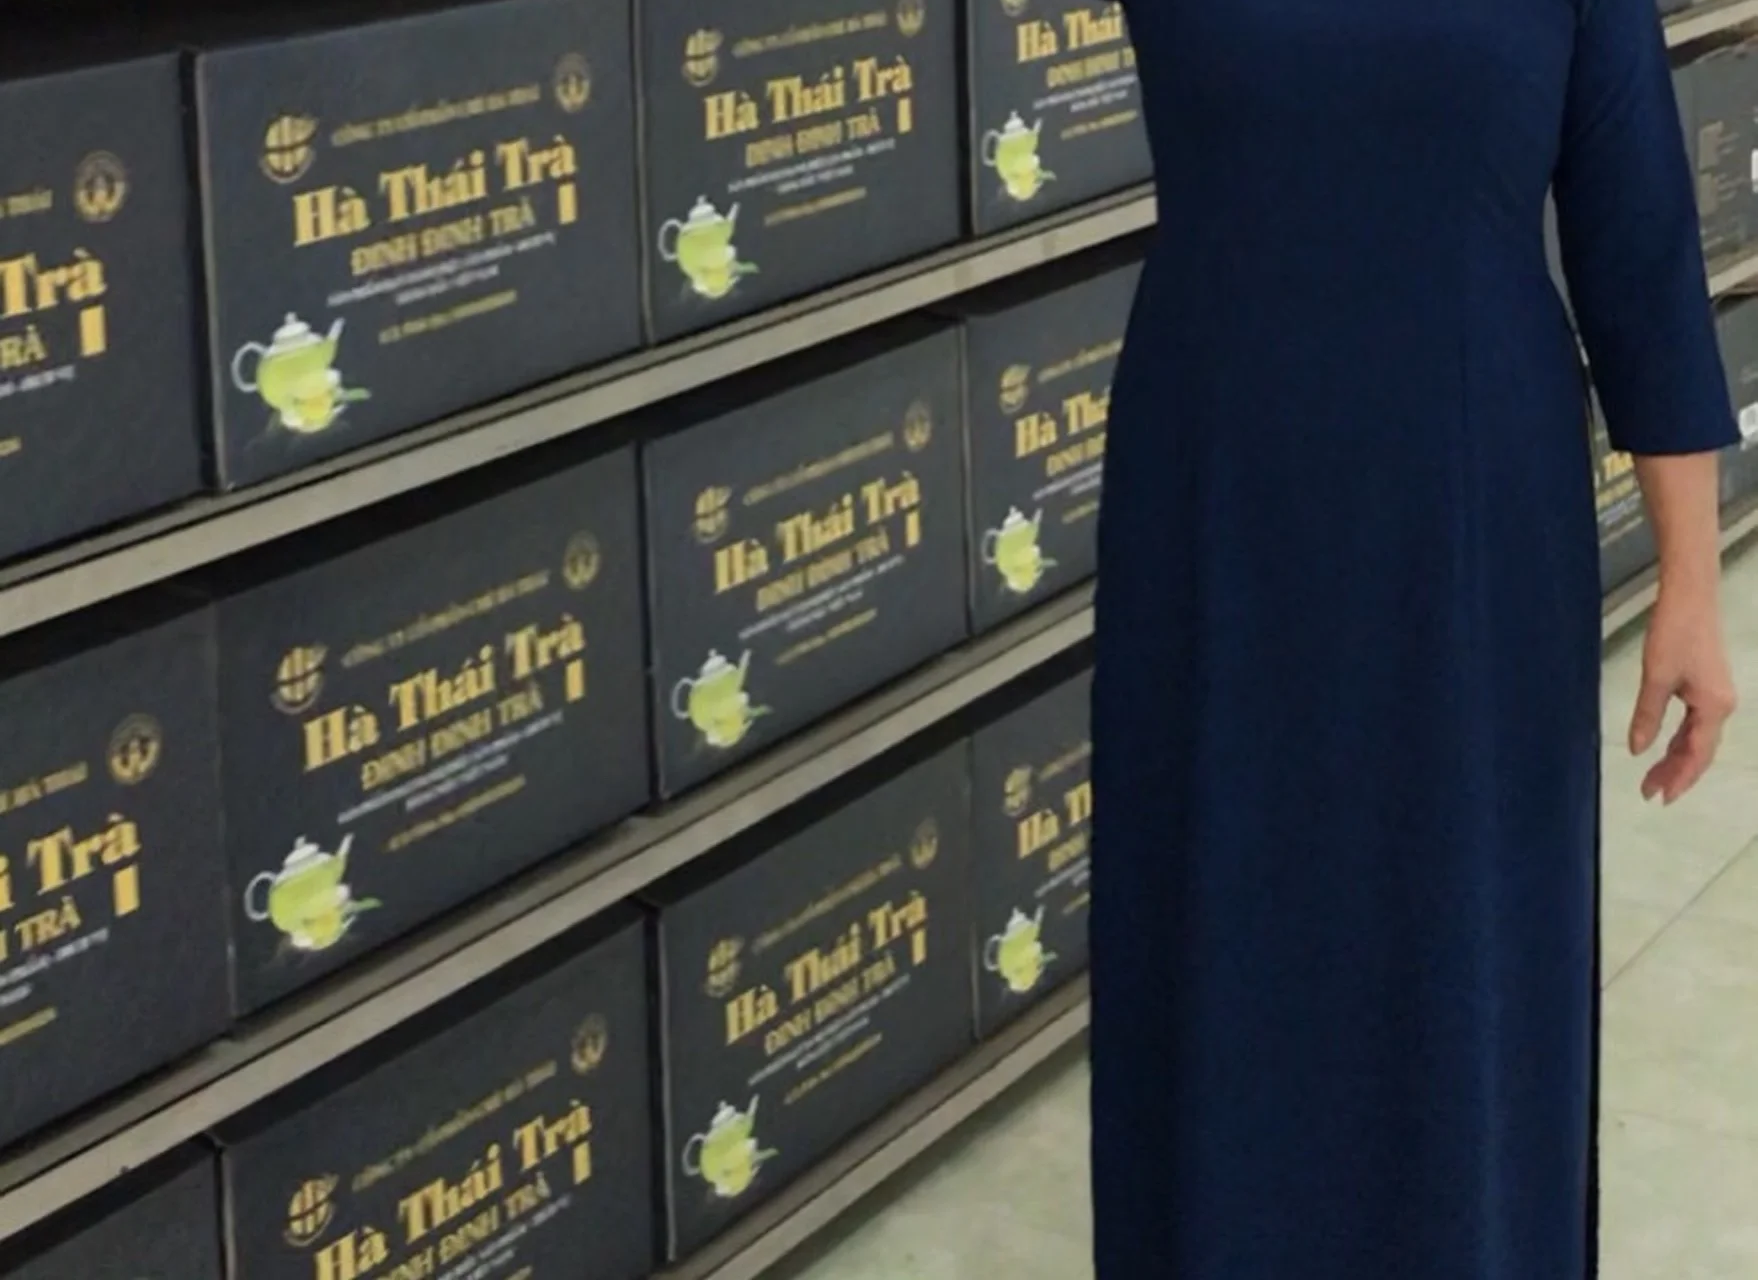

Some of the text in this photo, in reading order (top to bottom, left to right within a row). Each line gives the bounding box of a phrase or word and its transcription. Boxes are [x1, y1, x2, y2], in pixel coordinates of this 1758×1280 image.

[1017, 0, 1123, 64] Hà Thái
[704, 53, 913, 141] Hà Thái Trà
[292, 133, 578, 248] Hà Thái Trà
[0, 247, 107, 319] Trà
[1015, 411, 1057, 459] Hà
[714, 470, 920, 594] Hà Thái Trà
[303, 703, 381, 773] Hà
[389, 643, 497, 732] Thái
[504, 613, 587, 678] Trà
[25, 812, 141, 896] Trà
[14, 895, 82, 951] TRÀ
[725, 889, 927, 1046] Hà Thái Trà
[314, 1098, 593, 1280] Hà Thái Trà
